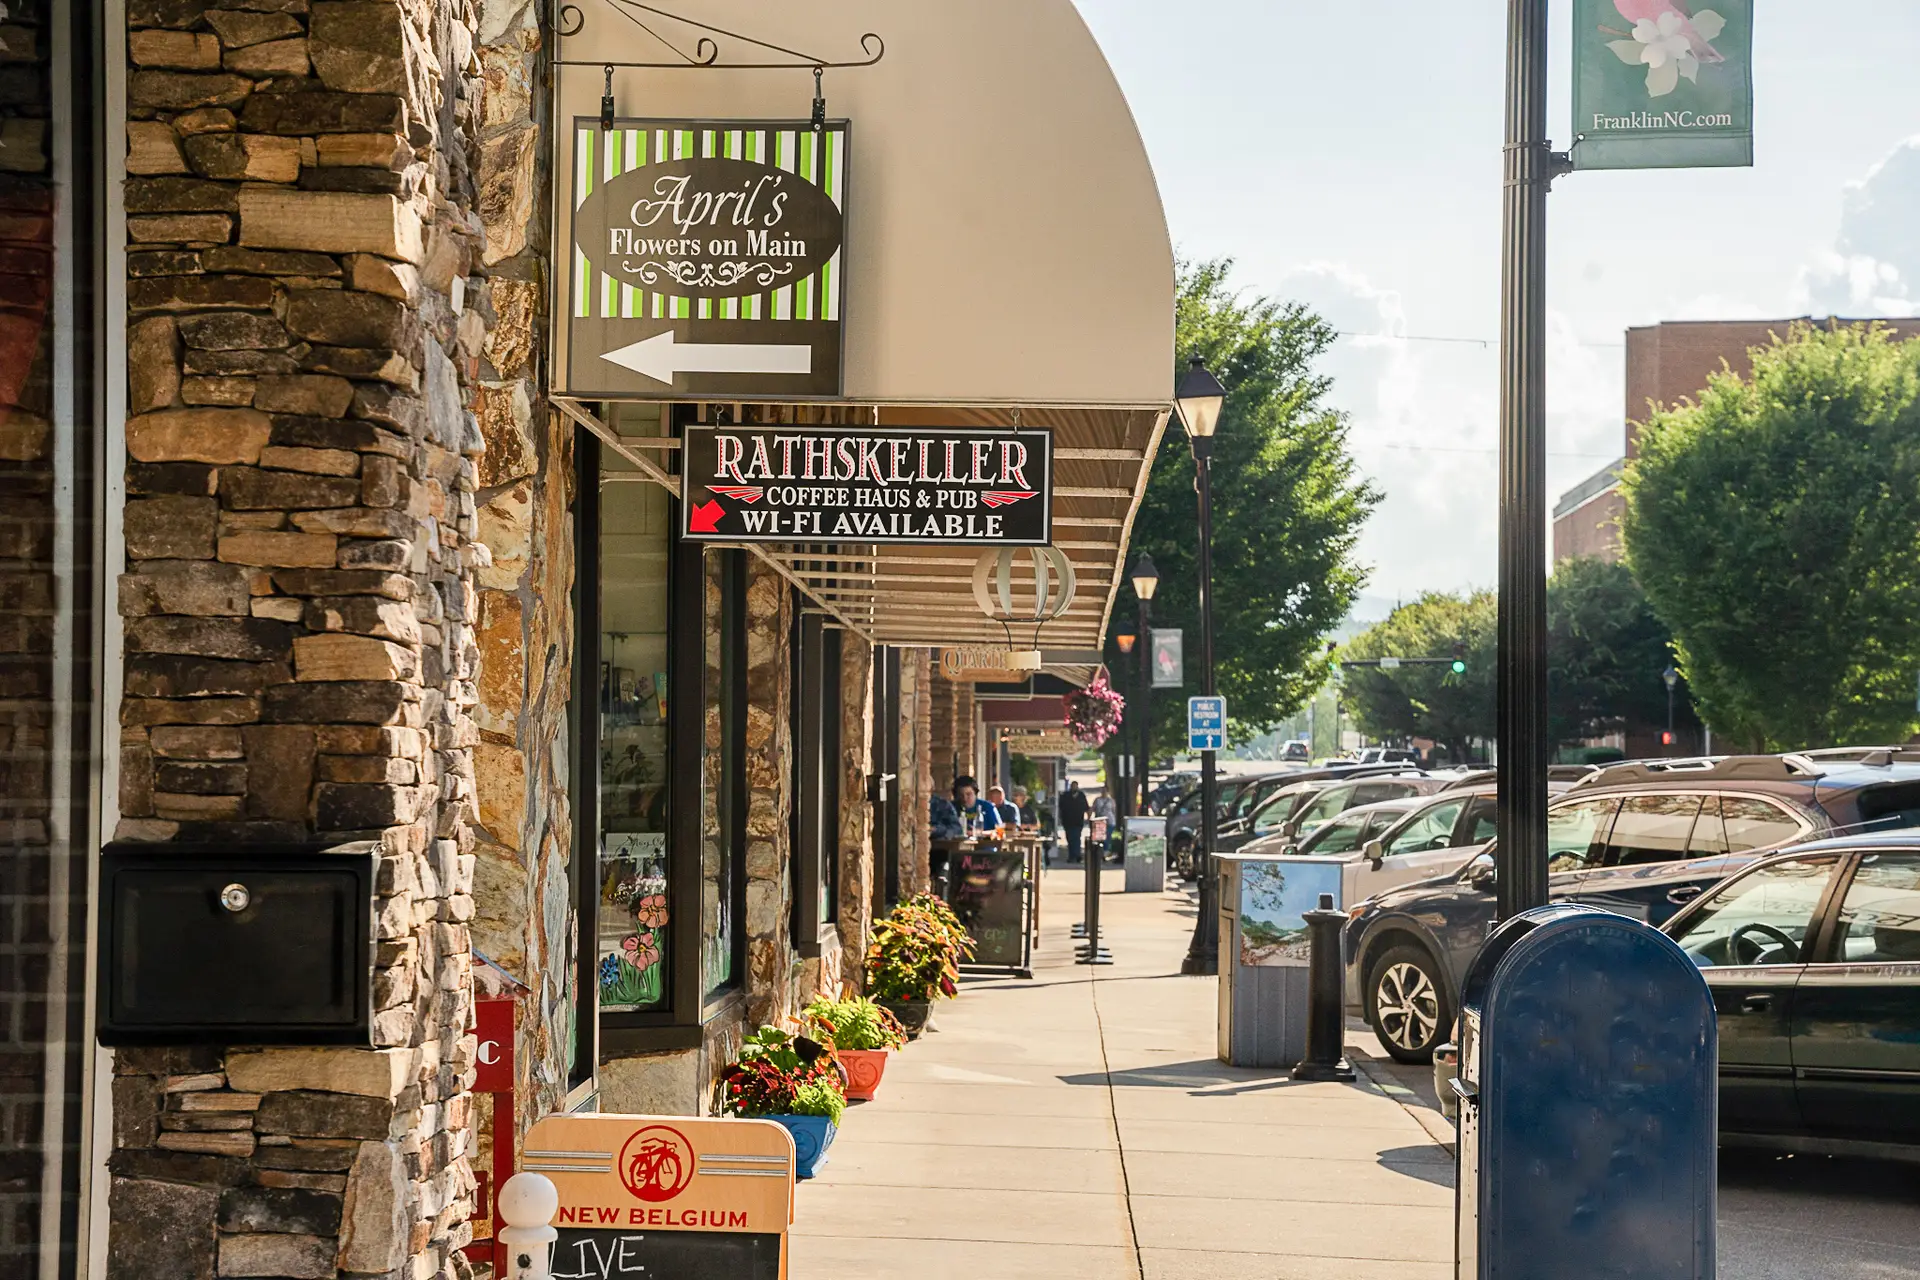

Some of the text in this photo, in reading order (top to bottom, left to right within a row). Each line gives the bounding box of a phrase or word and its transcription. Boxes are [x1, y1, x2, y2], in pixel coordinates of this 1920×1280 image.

[1592, 111, 1732, 130] FranklinNC.com
[630, 174, 788, 235] April's
[609, 228, 807, 257] Flowers on Main
[713, 434, 1032, 490] RATHSKELLER
[766, 486, 979, 510] COFFEE HAUS & PUB
[740, 510, 1004, 538] WI-FI AVAILABLE
[559, 1206, 748, 1228] NEW BELGIUM
[548, 1235, 645, 1280] LIVE
